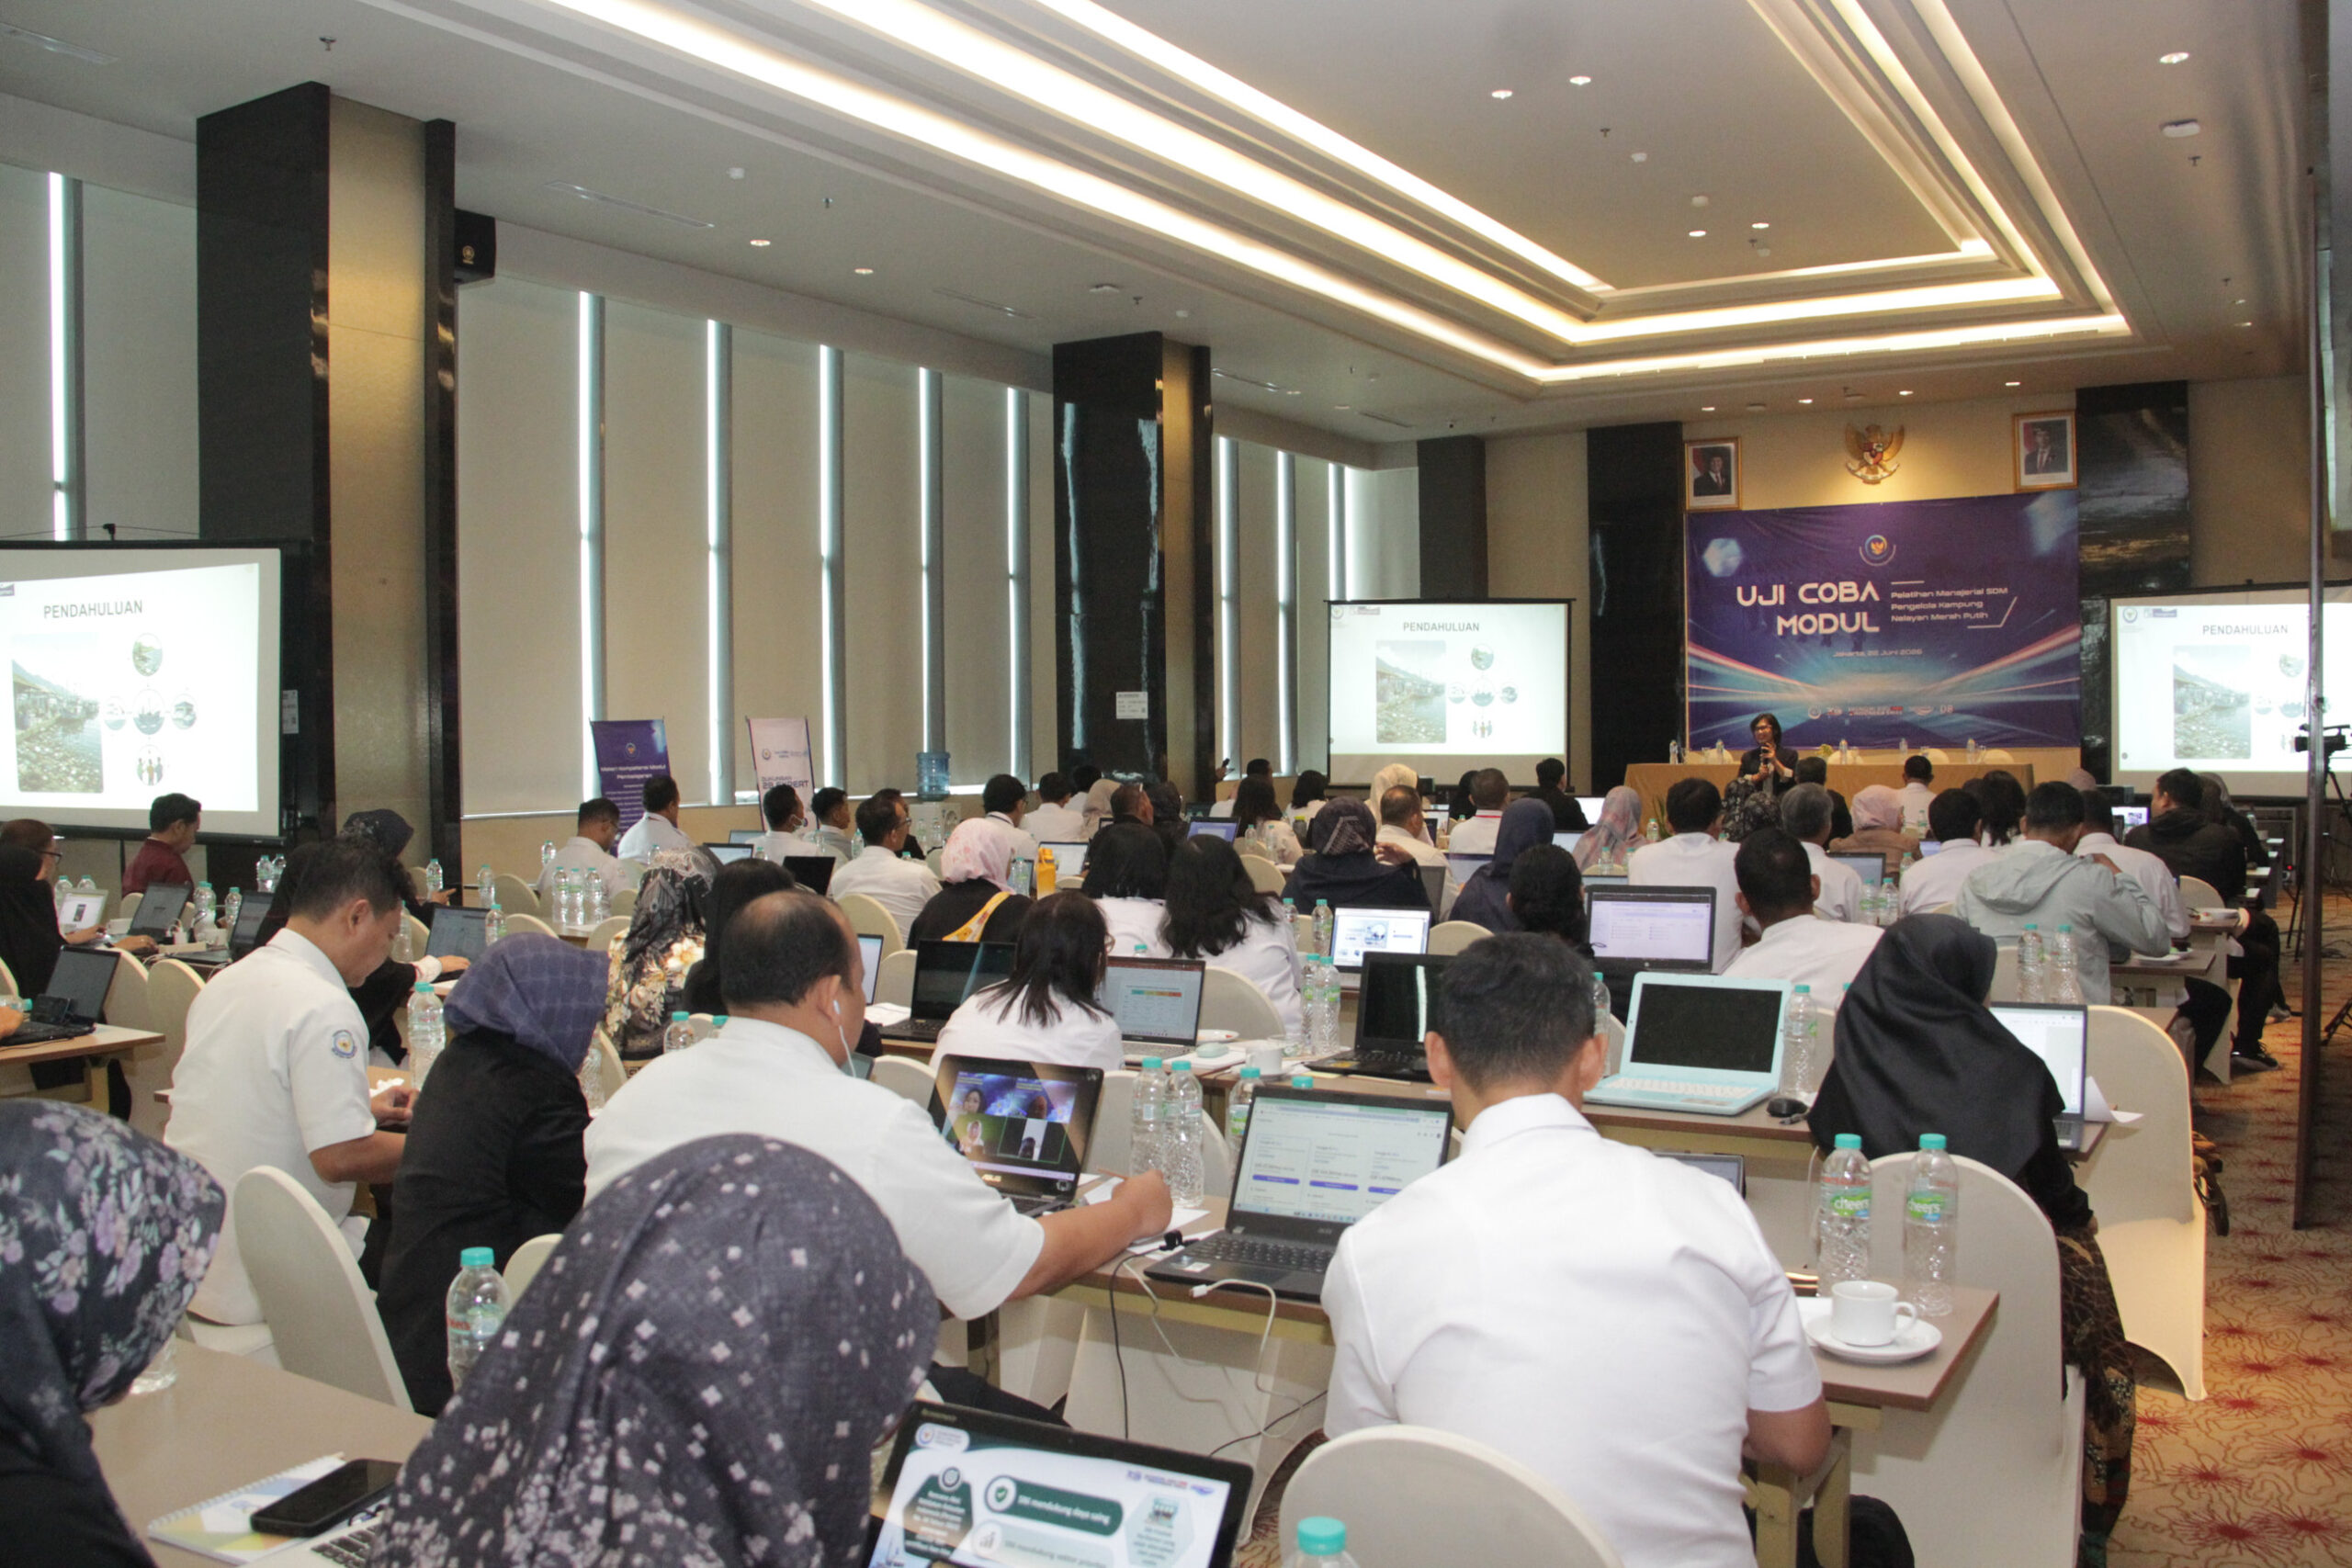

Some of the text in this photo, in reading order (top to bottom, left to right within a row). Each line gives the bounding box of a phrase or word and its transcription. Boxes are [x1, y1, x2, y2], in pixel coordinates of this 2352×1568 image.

[1736, 581, 1881, 606] UJI COBA
[1891, 590, 1934, 599] Pelatihan
[1936, 588, 1984, 597] Manajerial
[43, 600, 143, 619] PENDAHULUAN
[1891, 601, 1984, 611] Pengelola Kampung
[1777, 611, 1881, 636] MODUL
[1891, 614, 1928, 623] Nelayan
[1930, 613, 1962, 621] Merah
[1403, 622, 1480, 632] PENDAHULUAN
[2202, 625, 2289, 636] PENDAHULUAN
